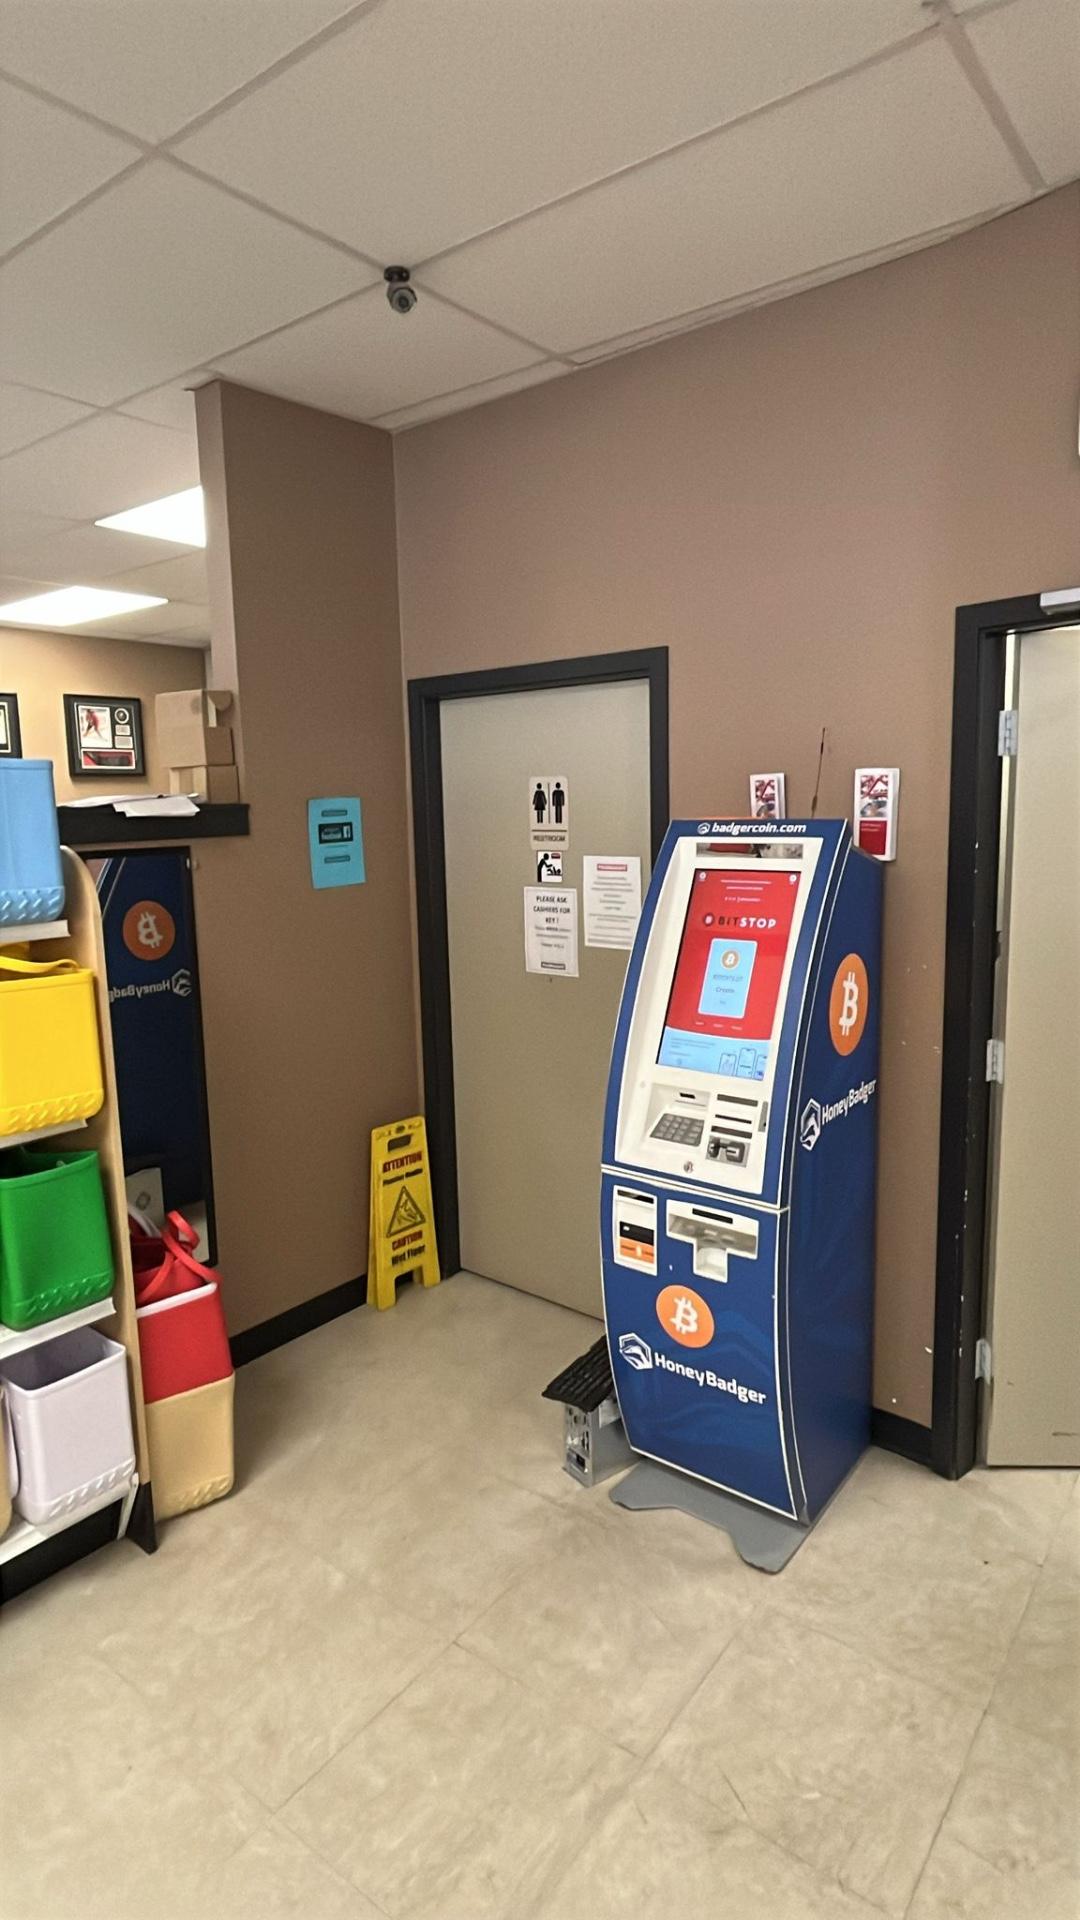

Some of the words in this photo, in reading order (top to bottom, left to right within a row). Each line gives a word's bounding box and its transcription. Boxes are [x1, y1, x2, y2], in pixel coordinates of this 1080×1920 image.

[711, 822, 807, 836] badgercoin.com
[535, 895, 555, 903] PLEASE
[556, 896, 568, 904] ASK
[822, 1079, 877, 1126] HoneyBadger
[654, 1351, 767, 1405] HoneyBadger
